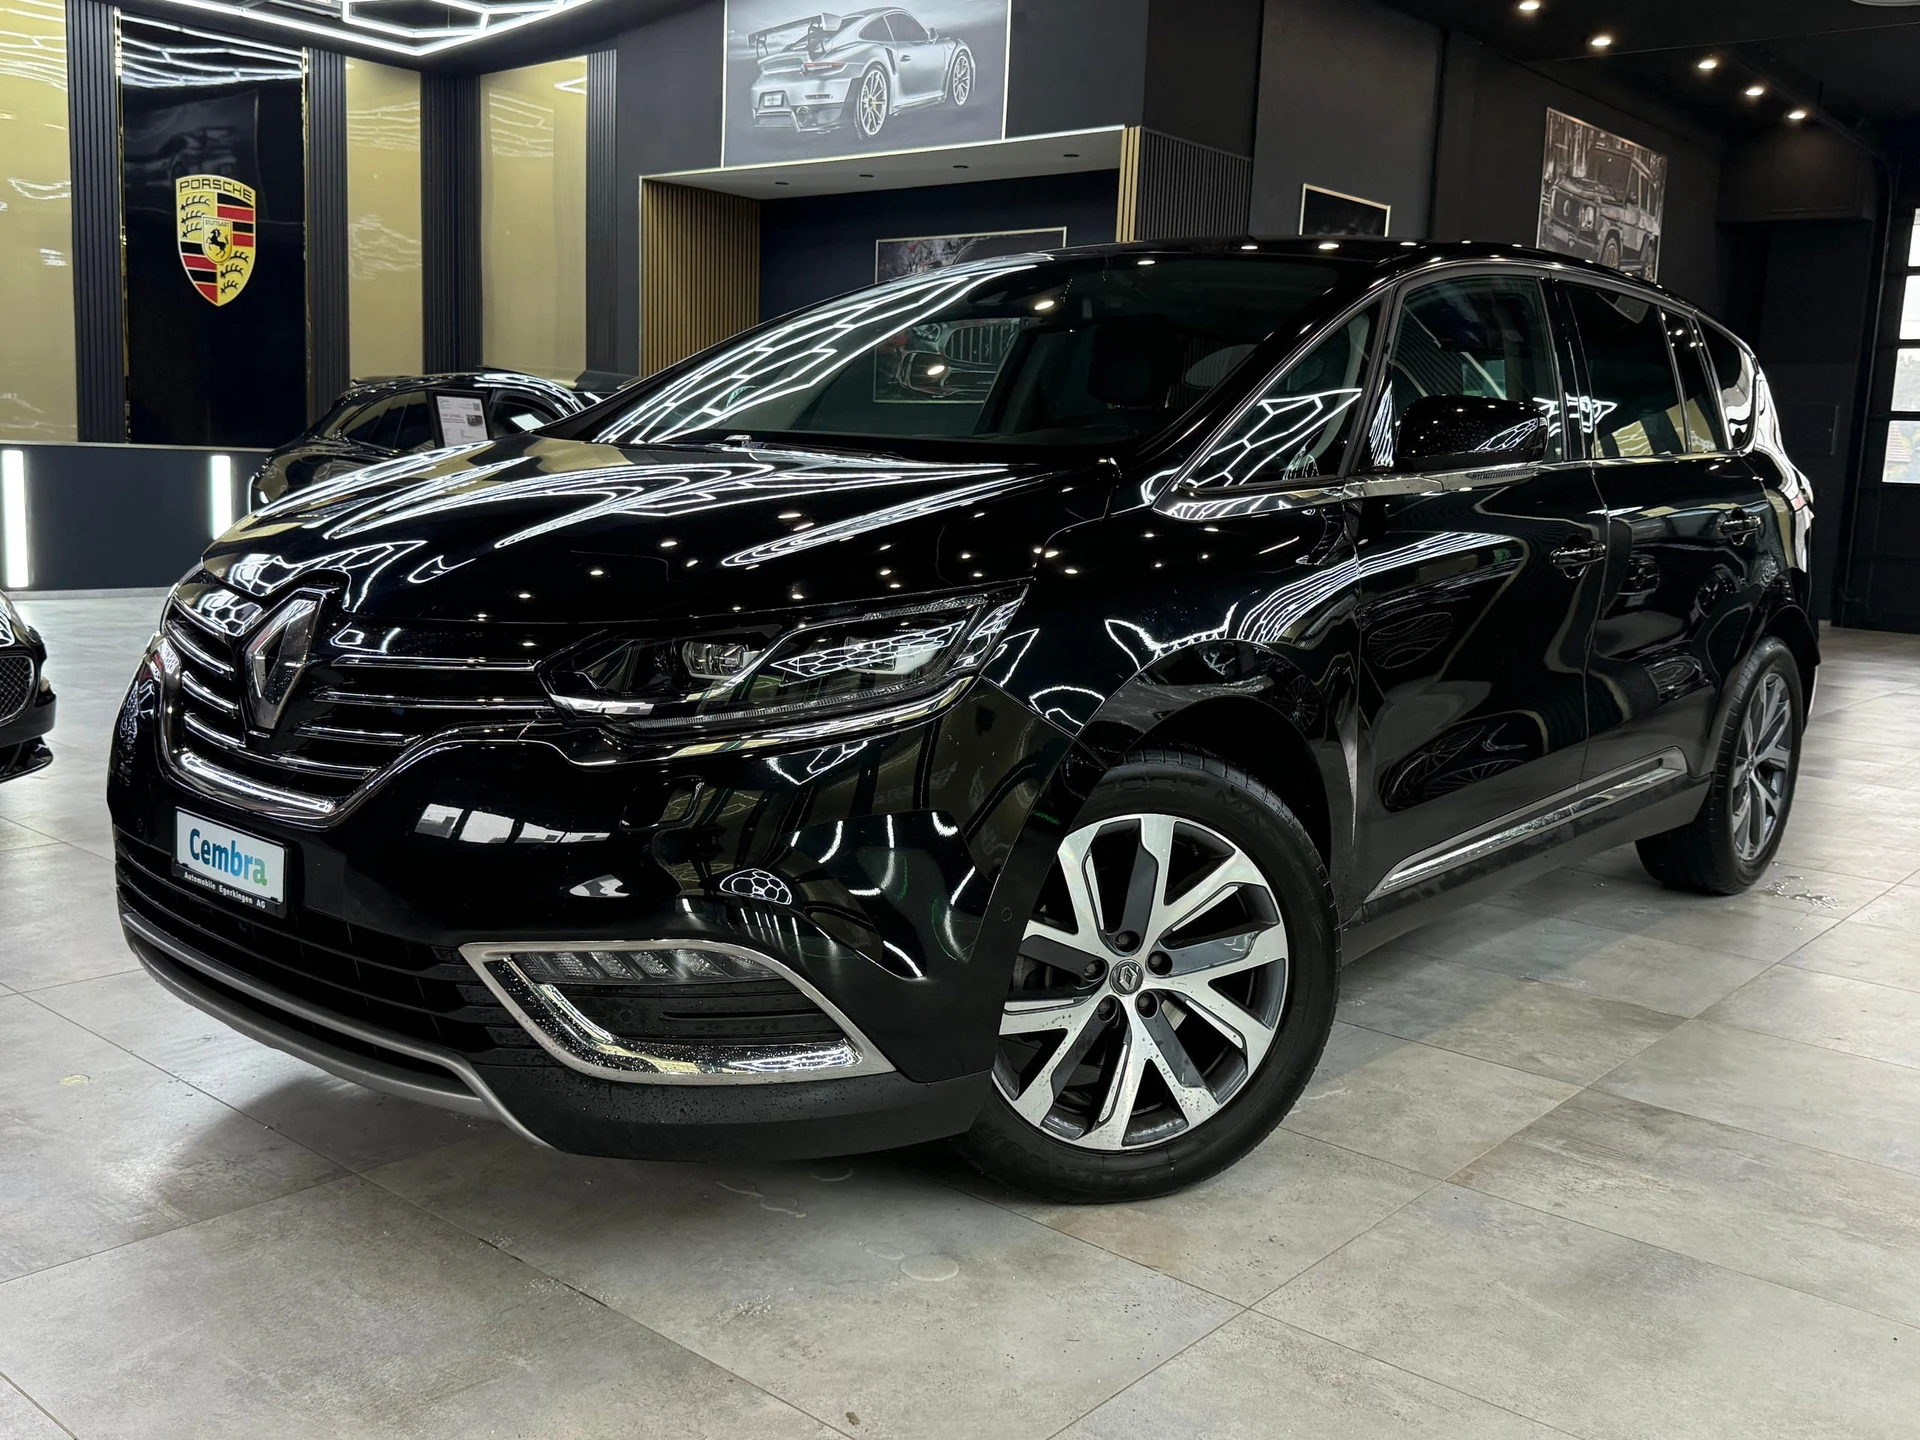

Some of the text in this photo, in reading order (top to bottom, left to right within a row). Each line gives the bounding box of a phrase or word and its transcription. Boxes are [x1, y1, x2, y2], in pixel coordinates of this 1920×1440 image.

[179, 178, 253, 202] PORSCHE
[189, 828, 268, 886] Cembra
[184, 871, 266, 909] Automobile Egerkingen AG
